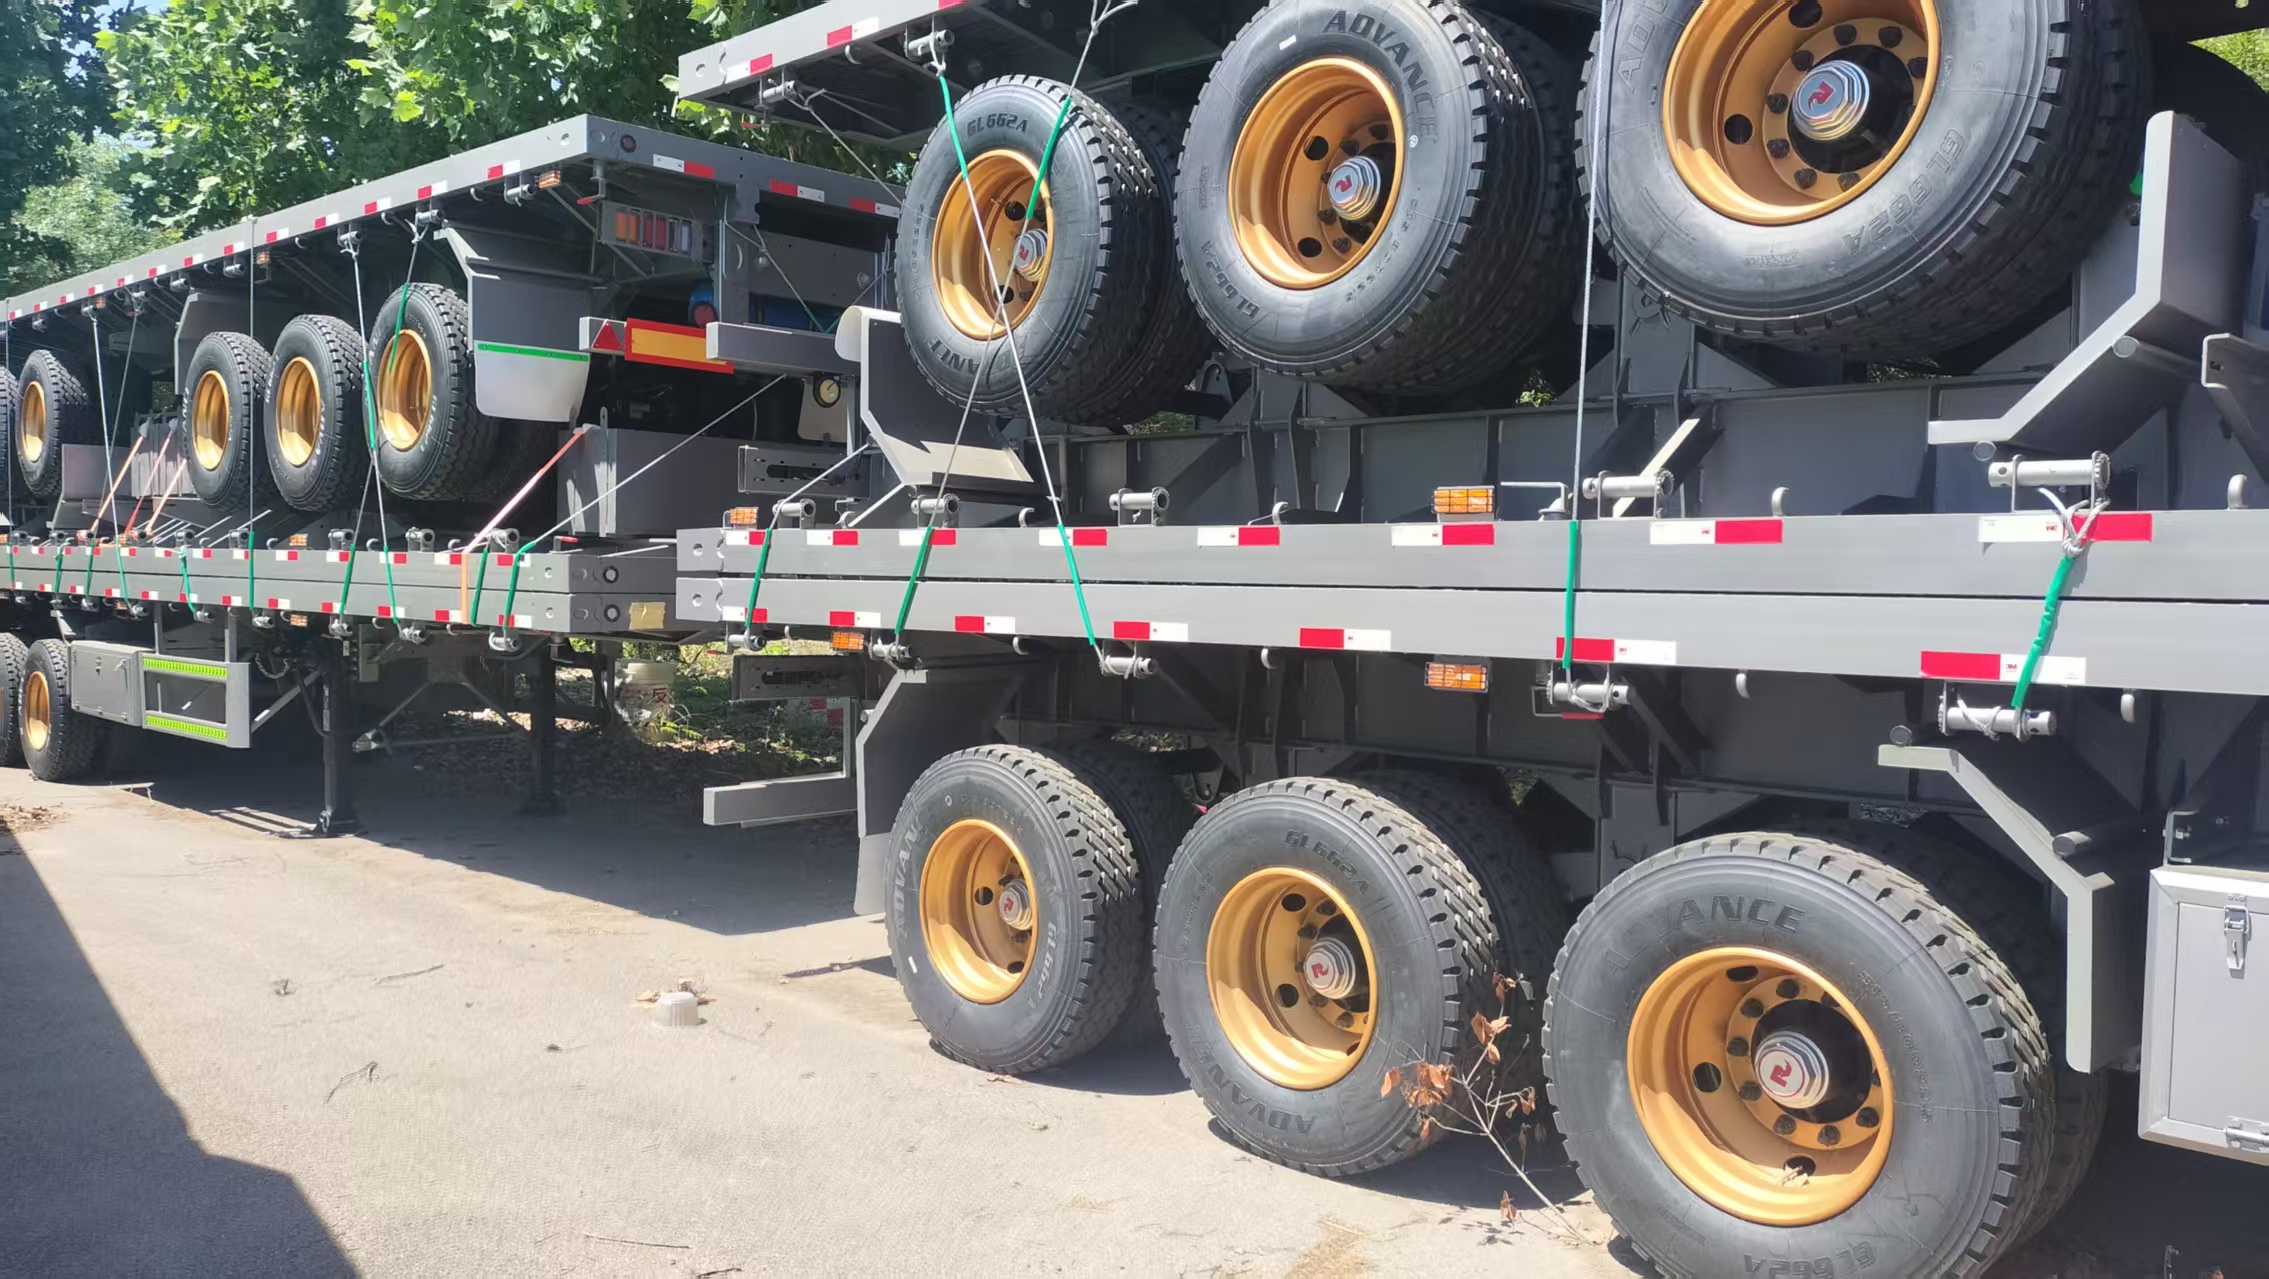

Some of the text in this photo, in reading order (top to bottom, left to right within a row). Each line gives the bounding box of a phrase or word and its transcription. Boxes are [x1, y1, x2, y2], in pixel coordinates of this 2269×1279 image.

[967, 113, 1028, 137] GL662A
[1843, 128, 1965, 255] GL662A
[1201, 240, 1260, 319] GL662A
